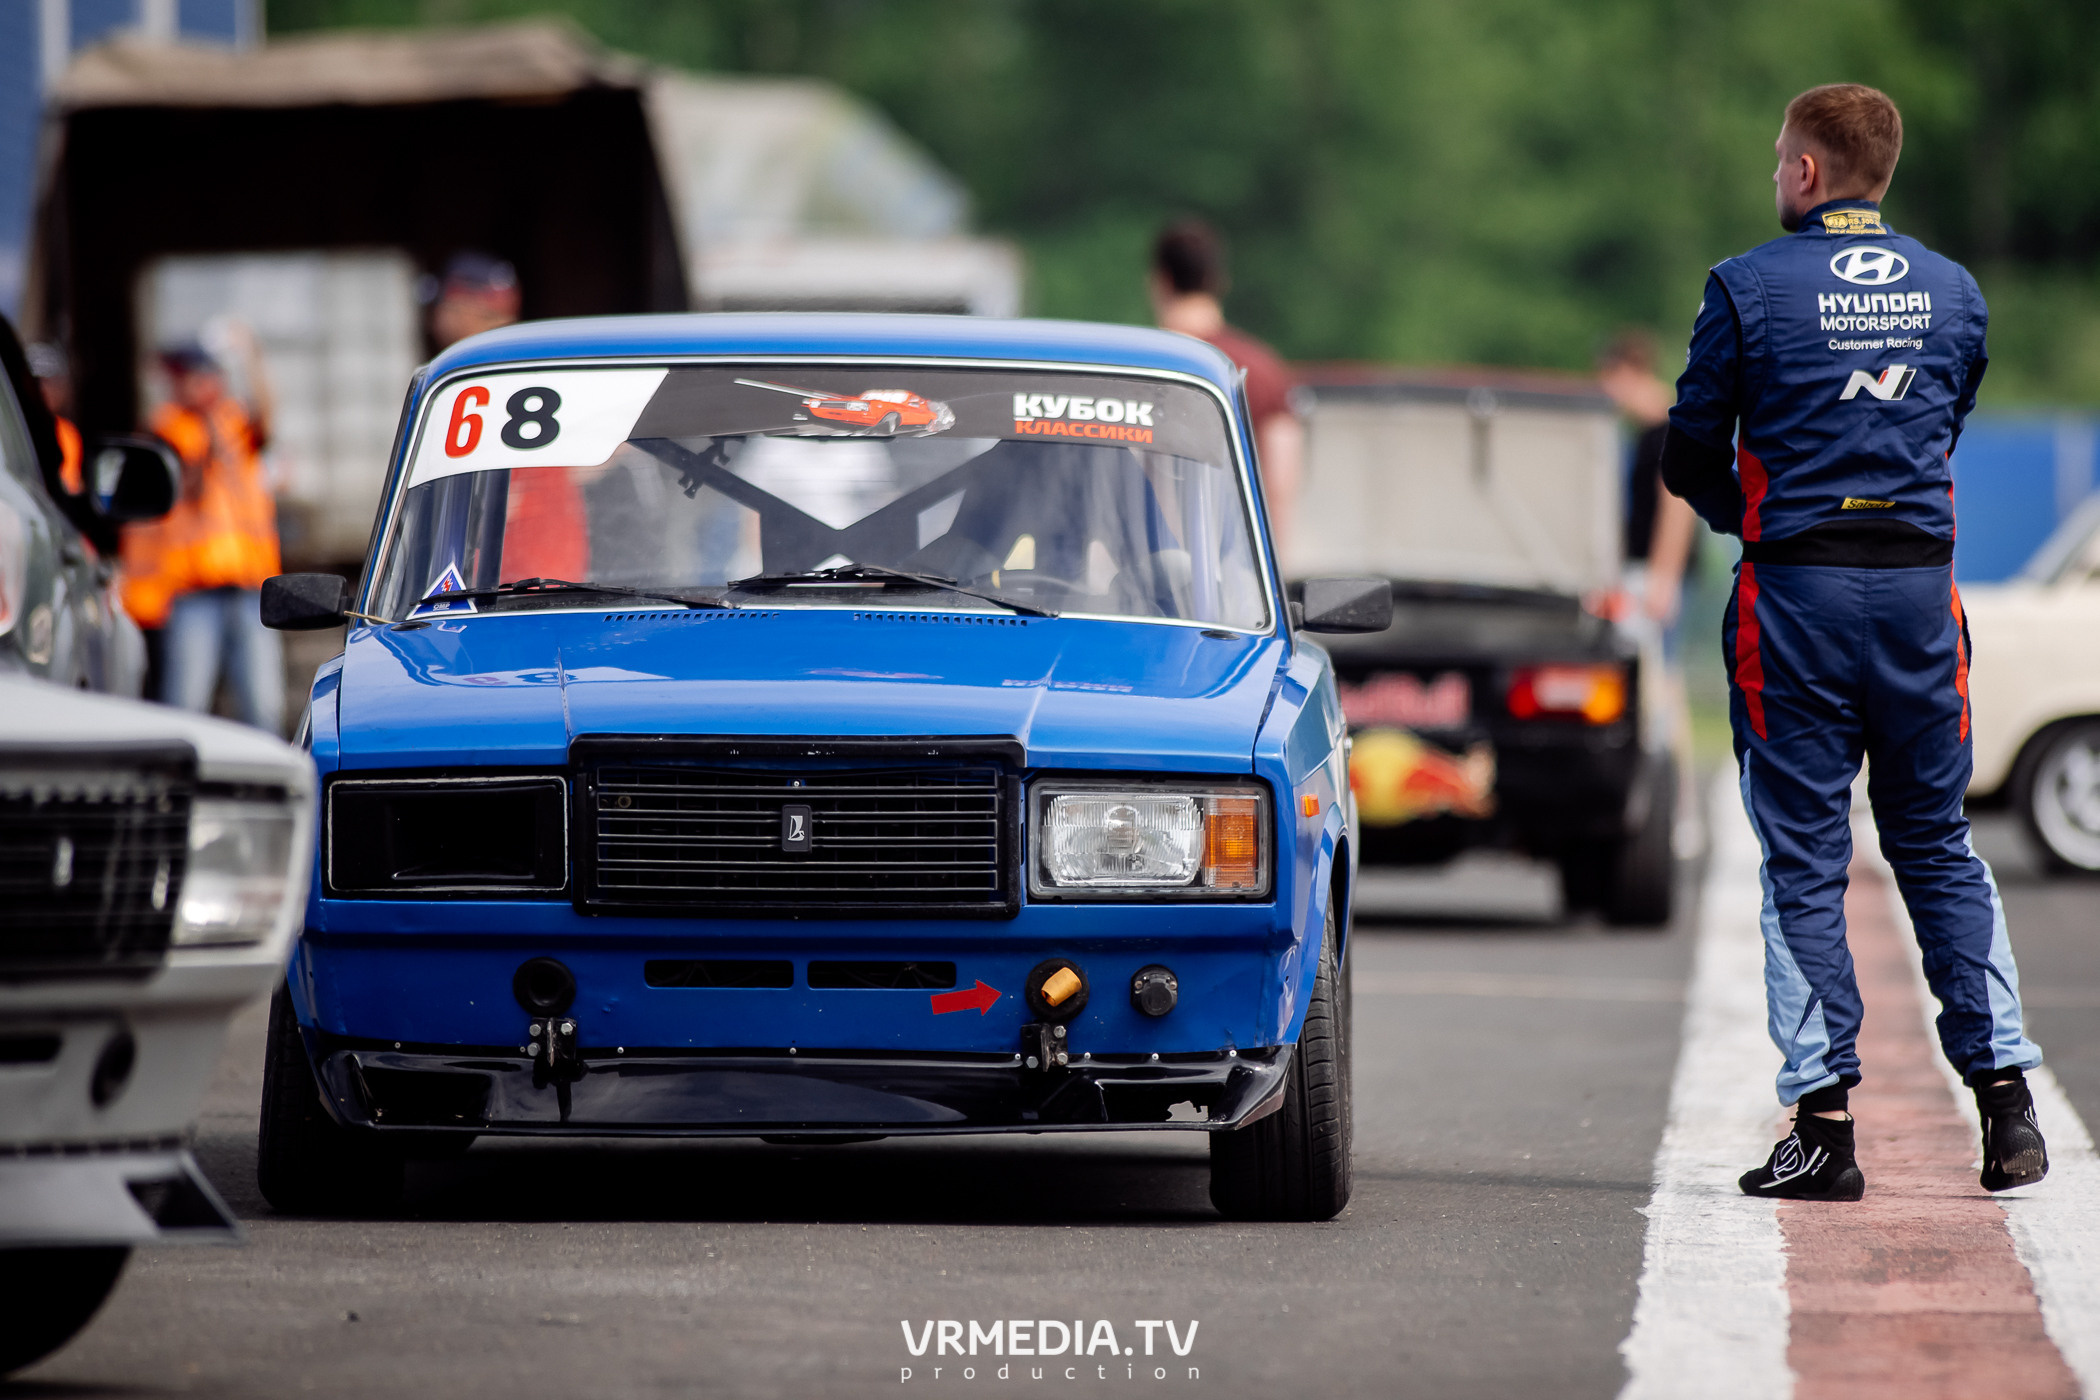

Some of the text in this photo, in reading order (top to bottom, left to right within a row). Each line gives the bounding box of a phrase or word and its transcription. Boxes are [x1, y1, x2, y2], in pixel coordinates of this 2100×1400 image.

[1818, 292, 1931, 313] HYUNDAI
[1820, 314, 1931, 331] MOTORSPORT
[1828, 335, 1923, 350] Customer Racing
[1013, 393, 1154, 426] КУБОК
[1015, 420, 1153, 444] КЛАССИКИ
